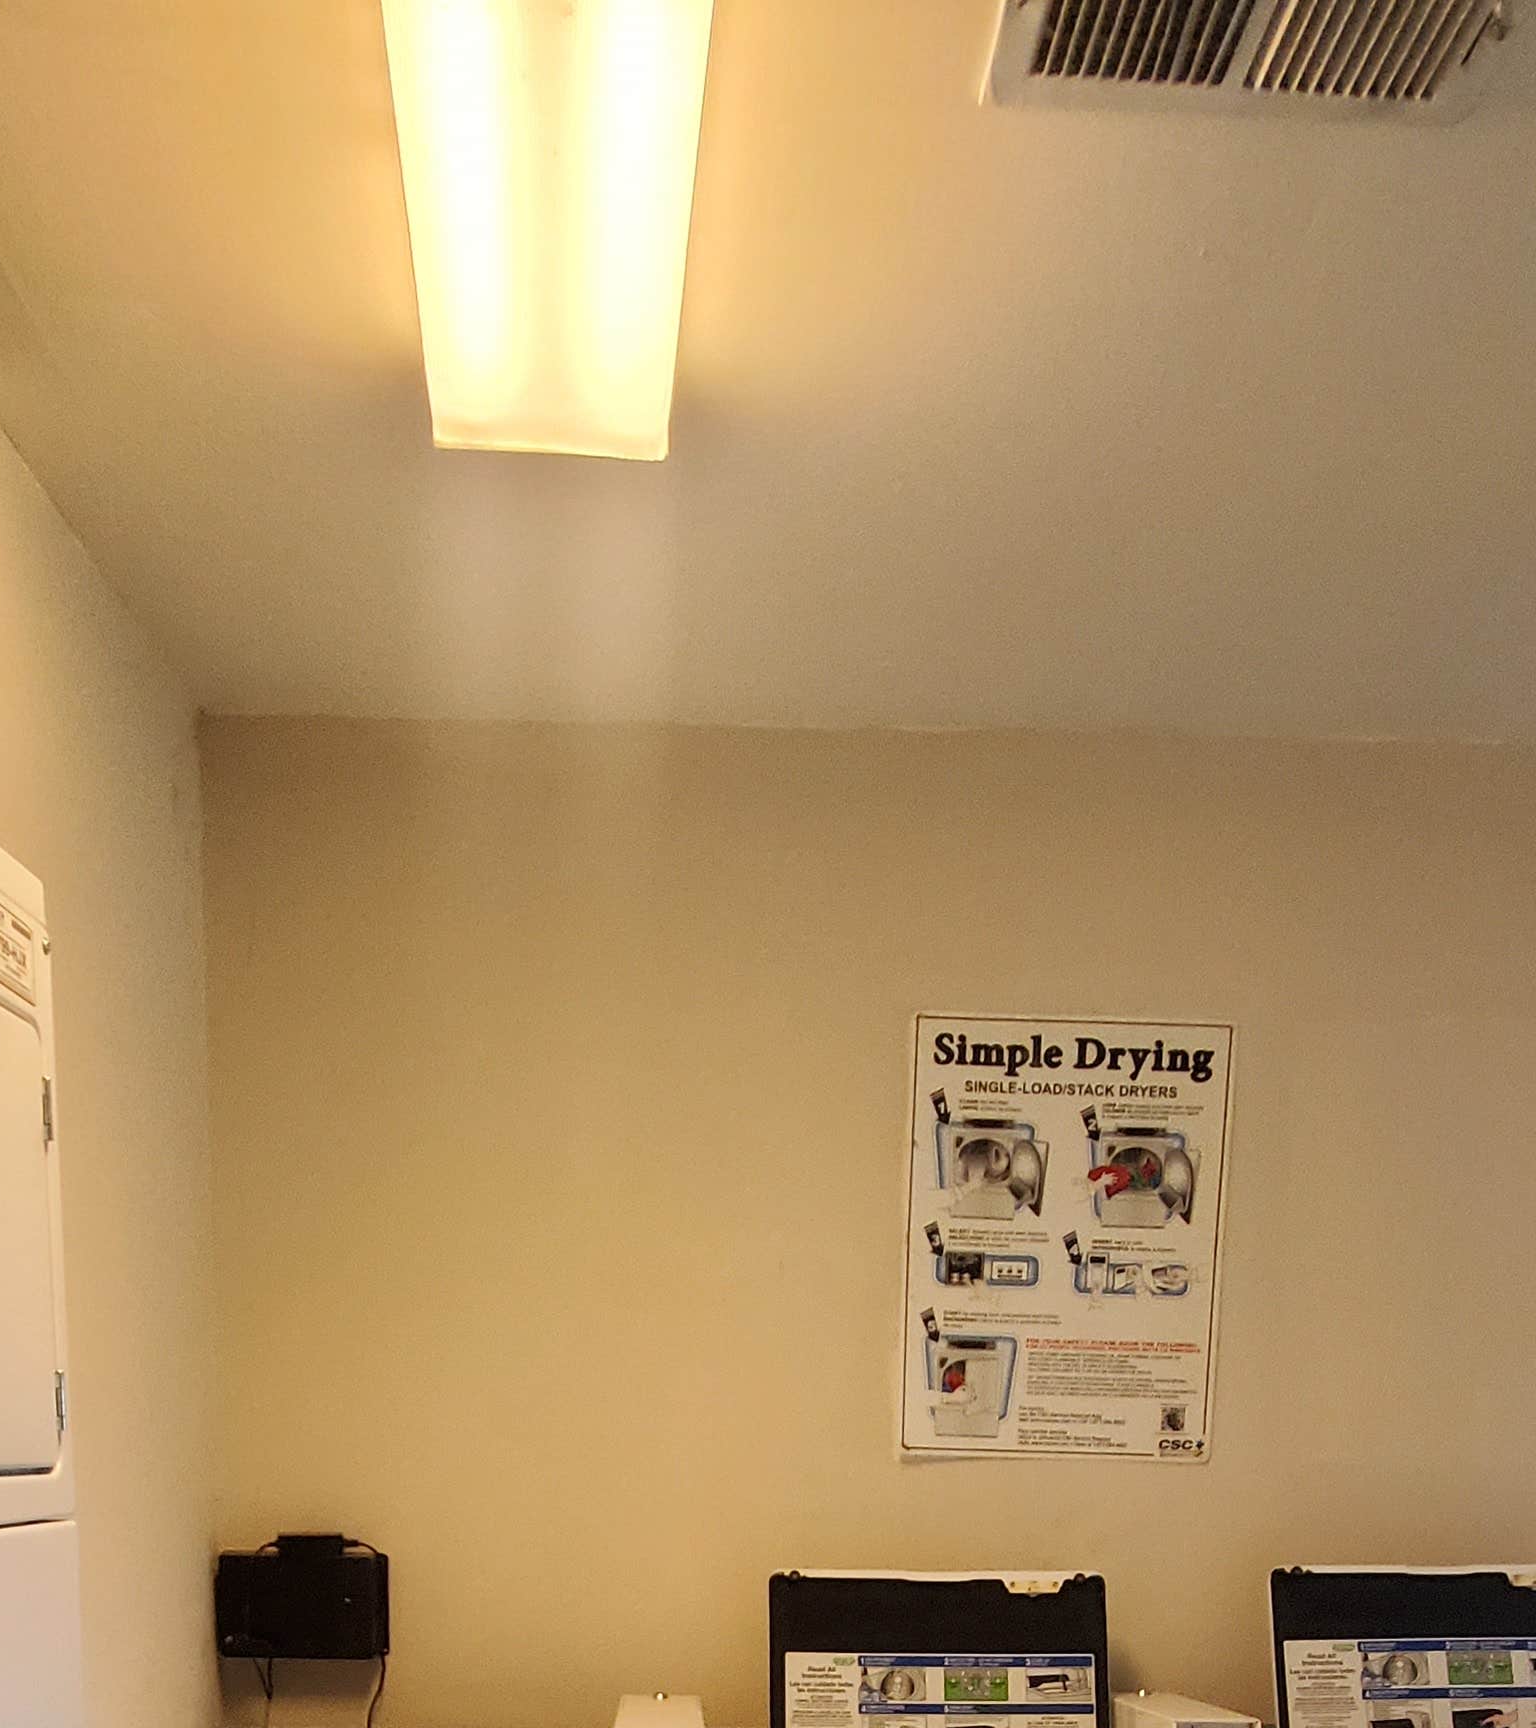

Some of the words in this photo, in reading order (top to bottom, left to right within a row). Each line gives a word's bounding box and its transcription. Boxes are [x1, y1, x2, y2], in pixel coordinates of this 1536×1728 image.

[933, 1032, 1063, 1076] Simple
[1073, 1037, 1215, 1083] Drying
[964, 1080, 1115, 1098] SINGLE-LOAD/STACK
[1119, 1085, 1178, 1099] DRYERS
[1159, 1439, 1193, 1450] CSC
